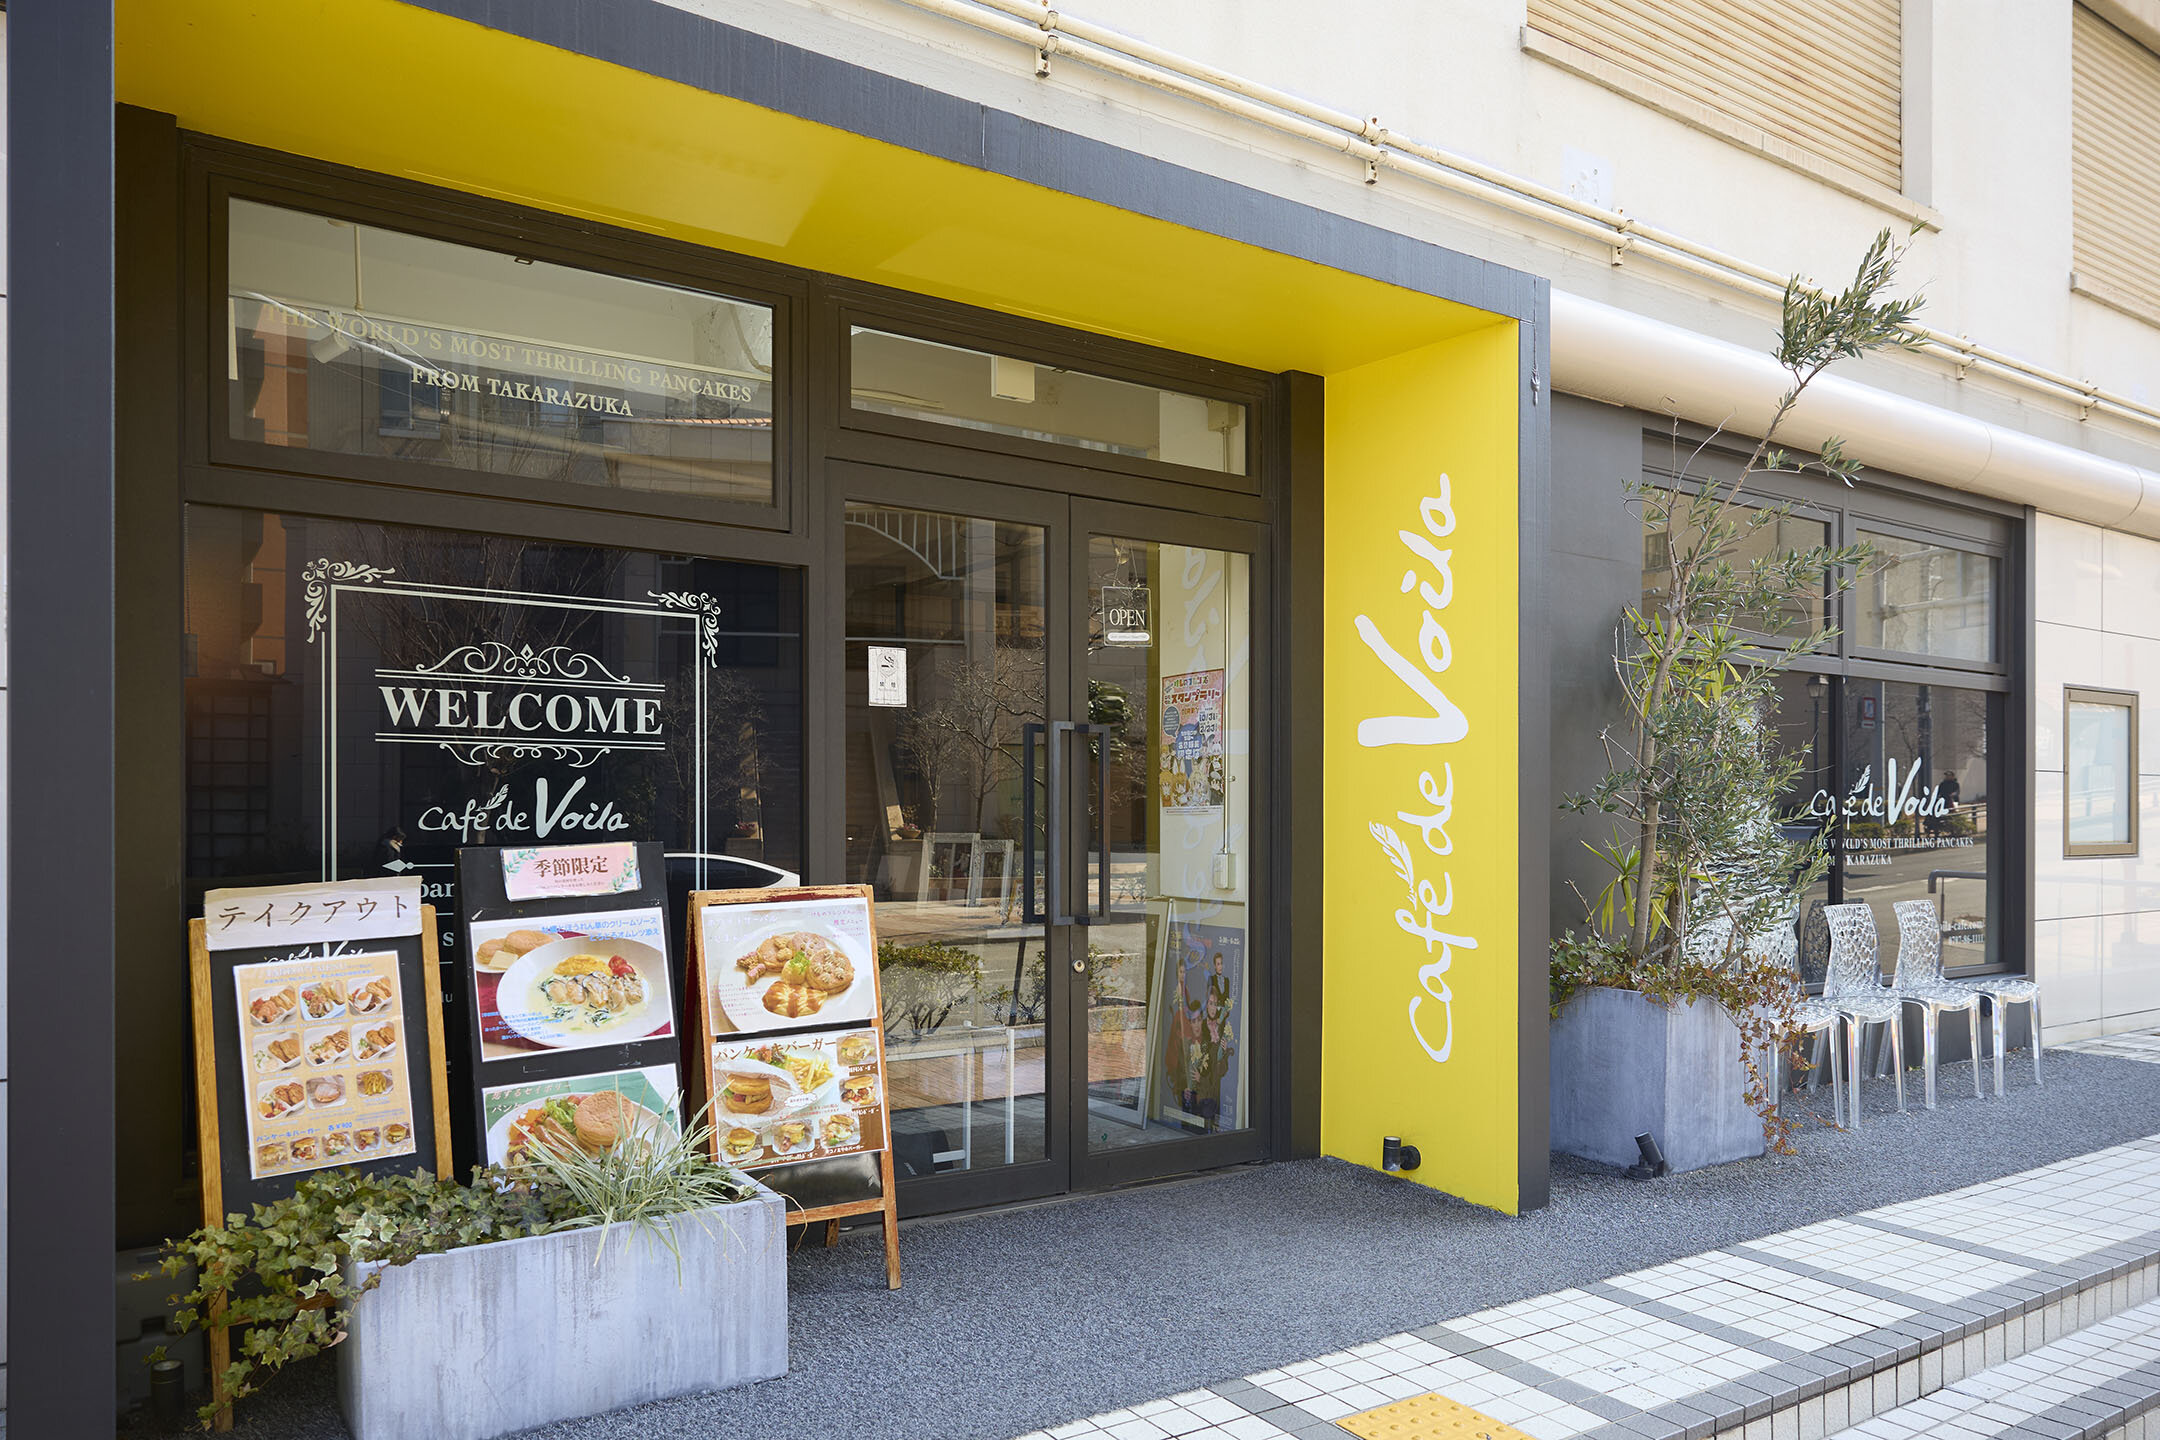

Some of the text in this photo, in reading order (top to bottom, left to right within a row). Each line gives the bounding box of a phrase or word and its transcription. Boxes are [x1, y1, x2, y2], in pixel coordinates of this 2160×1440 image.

[262, 303, 752, 403] THE WORLD'S MOST THRILLING PANCAKES
[411, 365, 633, 417] FROM TAKARAZUKA
[1109, 608, 1146, 626] OPEN
[1354, 472, 1469, 748] Voila
[378, 686, 664, 735] WELCOME
[496, 800, 531, 832] de
[535, 776, 630, 839] Voila
[1396, 761, 1454, 856] de
[1861, 783, 1885, 817] de
[1887, 757, 1950, 826] Voila
[534, 855, 609, 878] 季節限定
[1869, 838, 1893, 849] MOST
[1893, 837, 1936, 849] THRILLING
[1936, 836, 1974, 849] PANCAKES
[218, 895, 408, 931] テイクアウト
